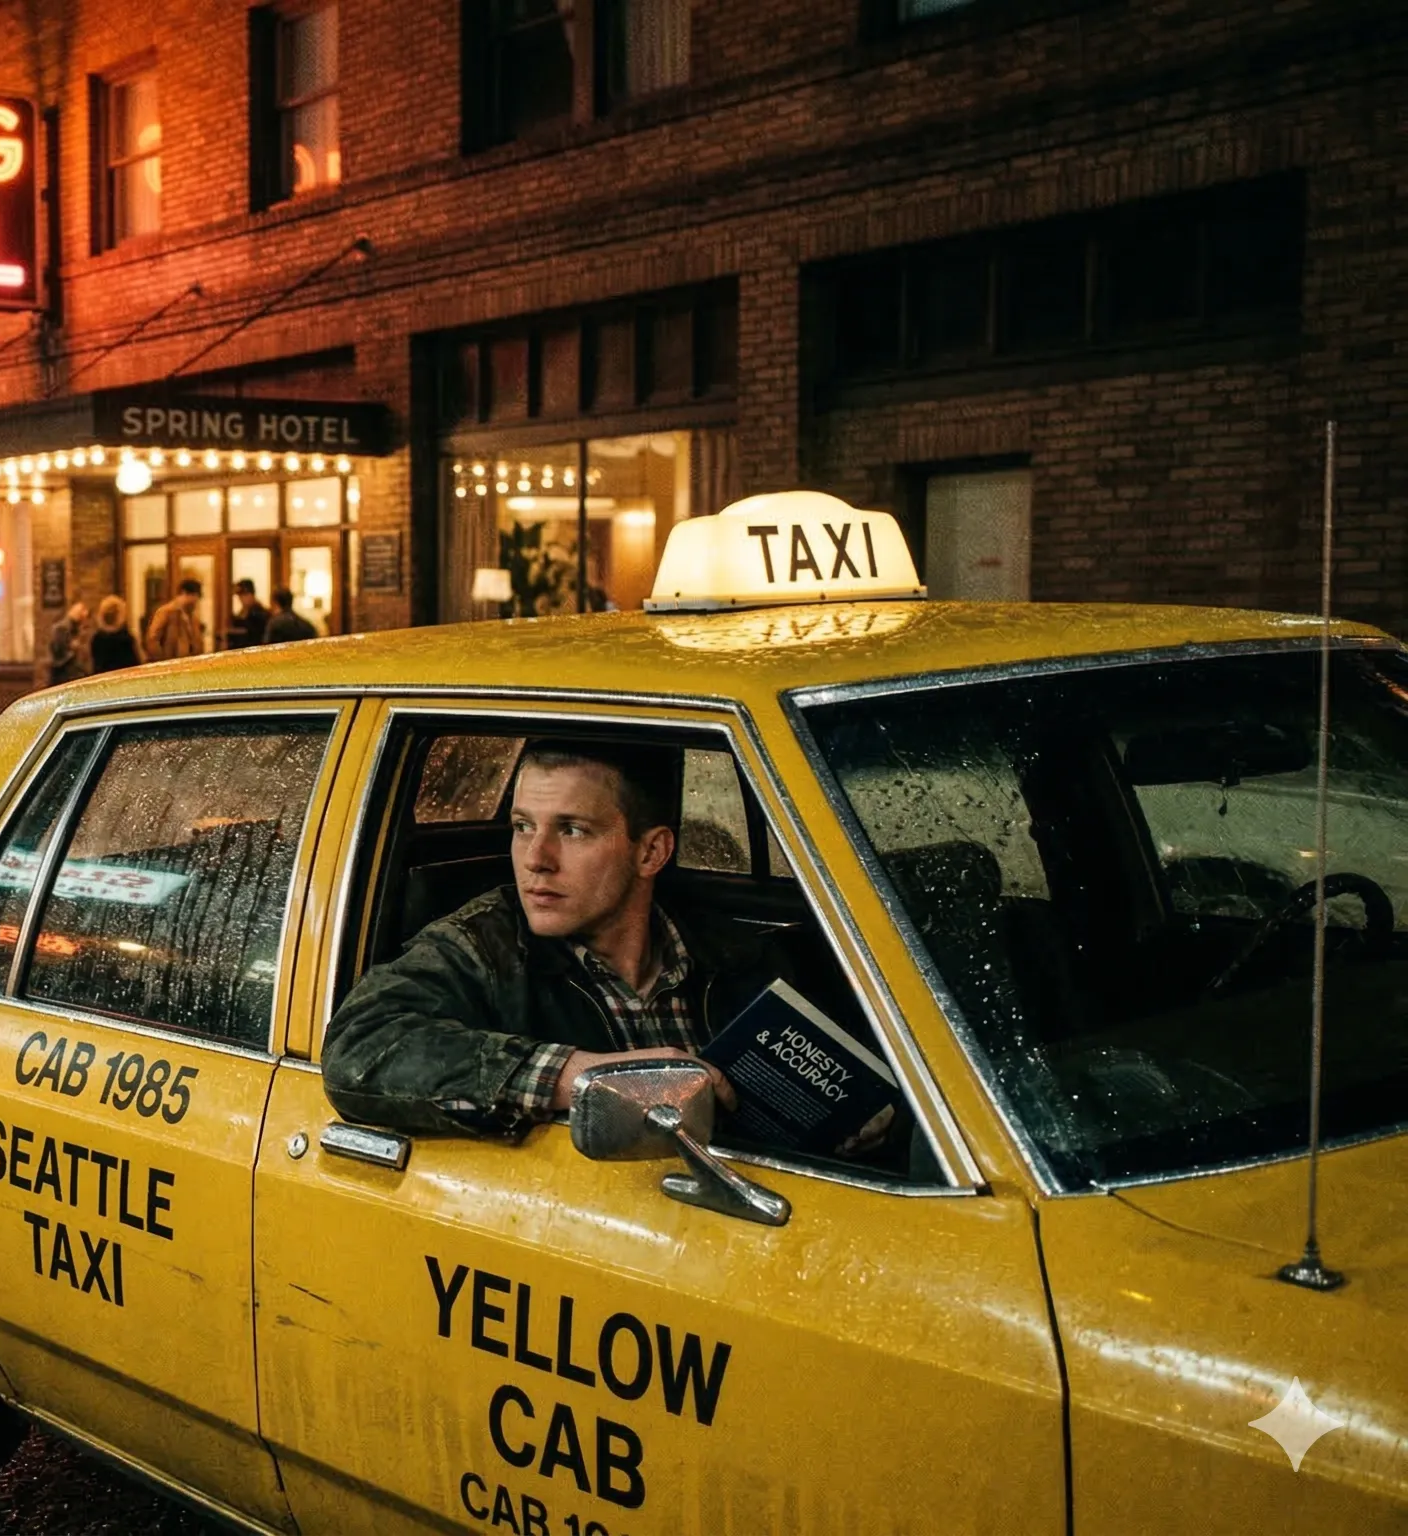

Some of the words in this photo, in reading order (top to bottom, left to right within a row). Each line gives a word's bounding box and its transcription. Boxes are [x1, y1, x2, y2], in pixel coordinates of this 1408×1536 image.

[121, 407, 244, 439] SPRING
[259, 415, 360, 444] HOTEL
[747, 522, 878, 583] TAXI
[16, 1031, 96, 1097] CAB
[99, 1051, 199, 1124] 1985
[756, 1030, 770, 1046] &
[769, 1040, 849, 1102] ACCURACY
[780, 1025, 853, 1083] HONESTY
[23, 1210, 125, 1307] TAXI
[424, 1255, 732, 1427] YELLOW
[488, 1384, 646, 1510] CAB
[460, 1472, 551, 1536] CAB
